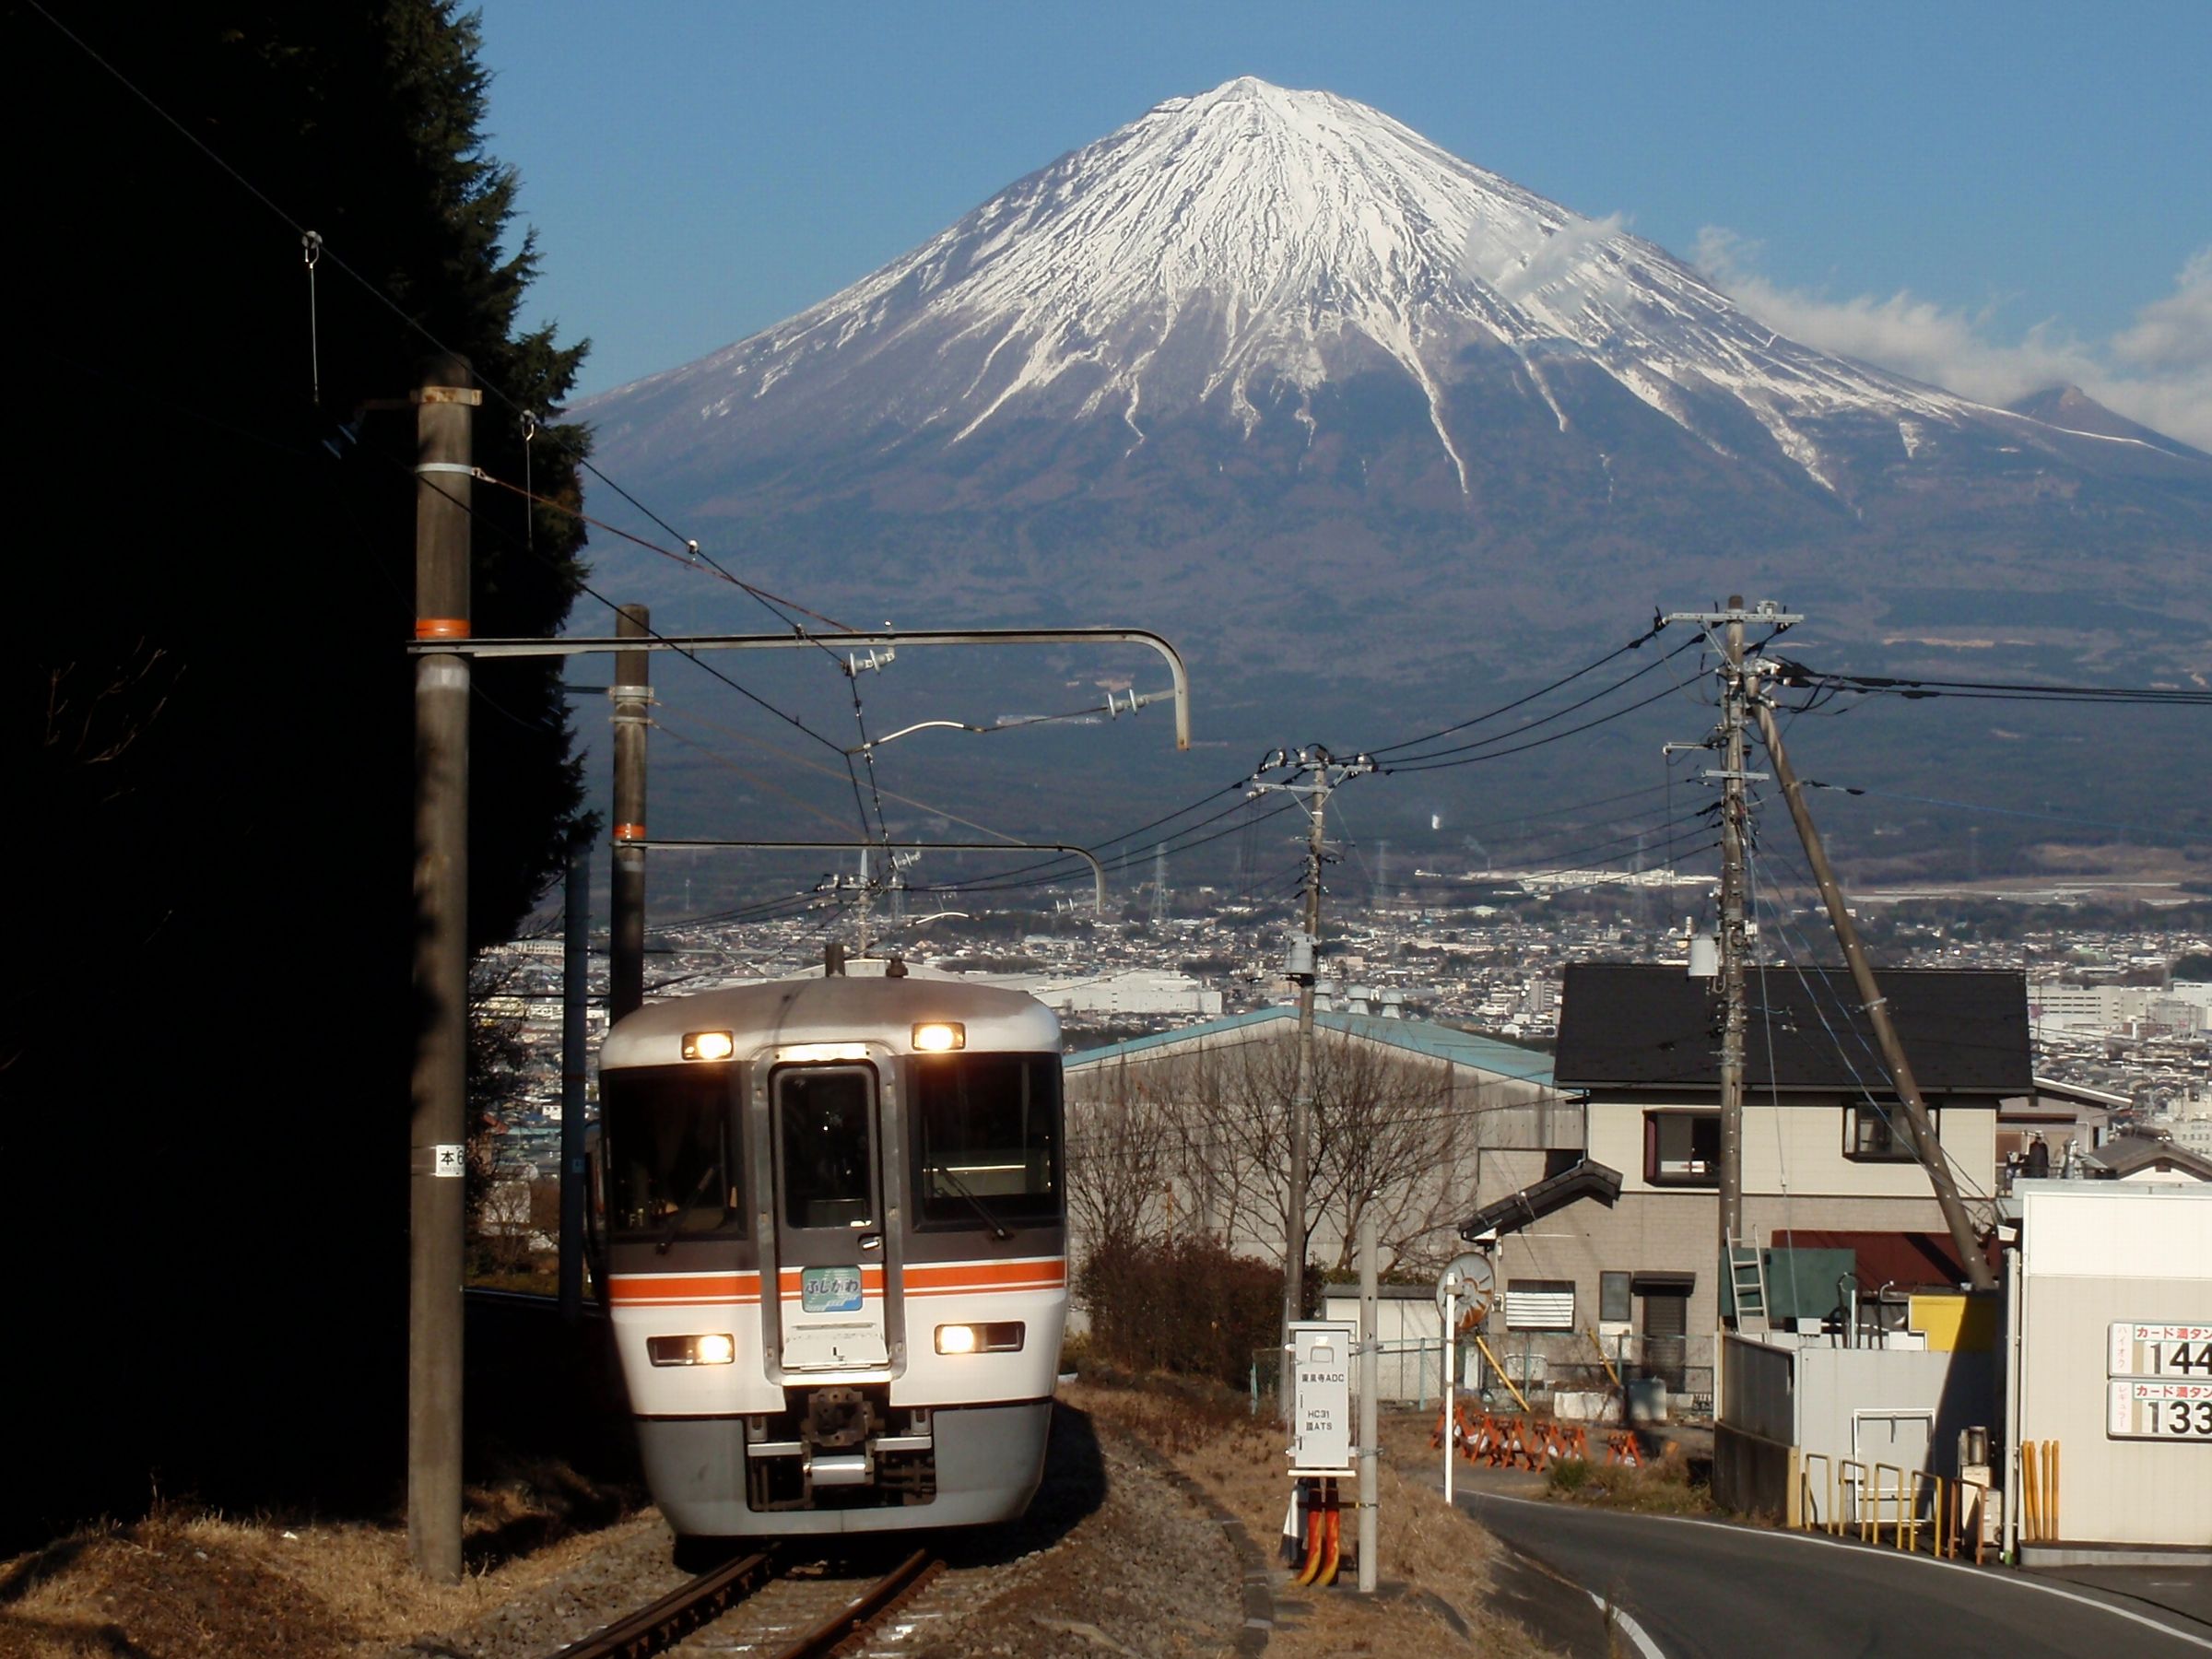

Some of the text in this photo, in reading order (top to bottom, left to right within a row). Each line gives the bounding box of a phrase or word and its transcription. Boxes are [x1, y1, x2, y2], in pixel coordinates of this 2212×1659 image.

[806, 1278, 859, 1294] ふじかわ
[2149, 1342, 2212, 1374] 144
[1307, 1409, 1330, 1419] HC31
[2147, 1401, 2212, 1435] 133
